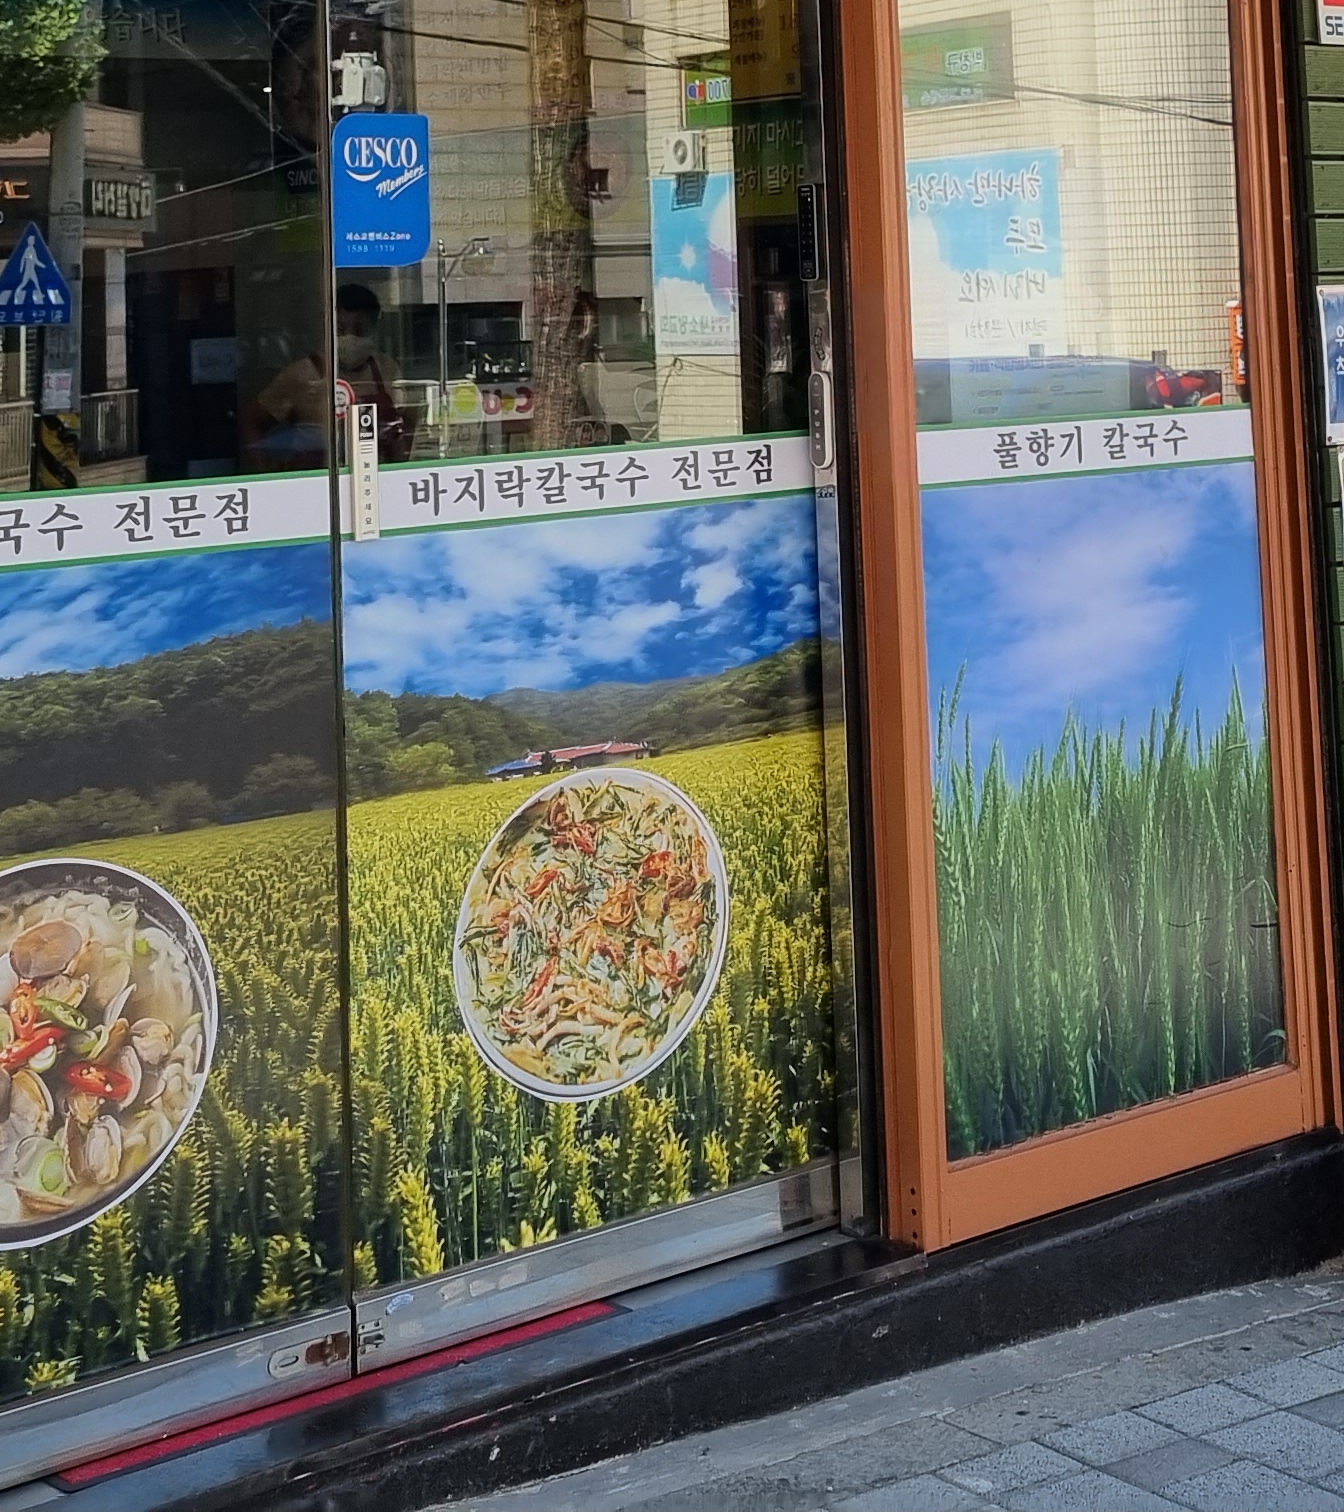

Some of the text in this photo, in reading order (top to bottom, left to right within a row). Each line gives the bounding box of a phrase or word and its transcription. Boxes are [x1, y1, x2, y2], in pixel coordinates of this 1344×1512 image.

[344, 136, 418, 168] CESCO
[376, 164, 425, 198] Members
[992, 420, 1189, 472] 풀향기 칼국수
[407, 442, 777, 516] 바지락칼국수 전문점
[111, 485, 252, 552] 전문점
